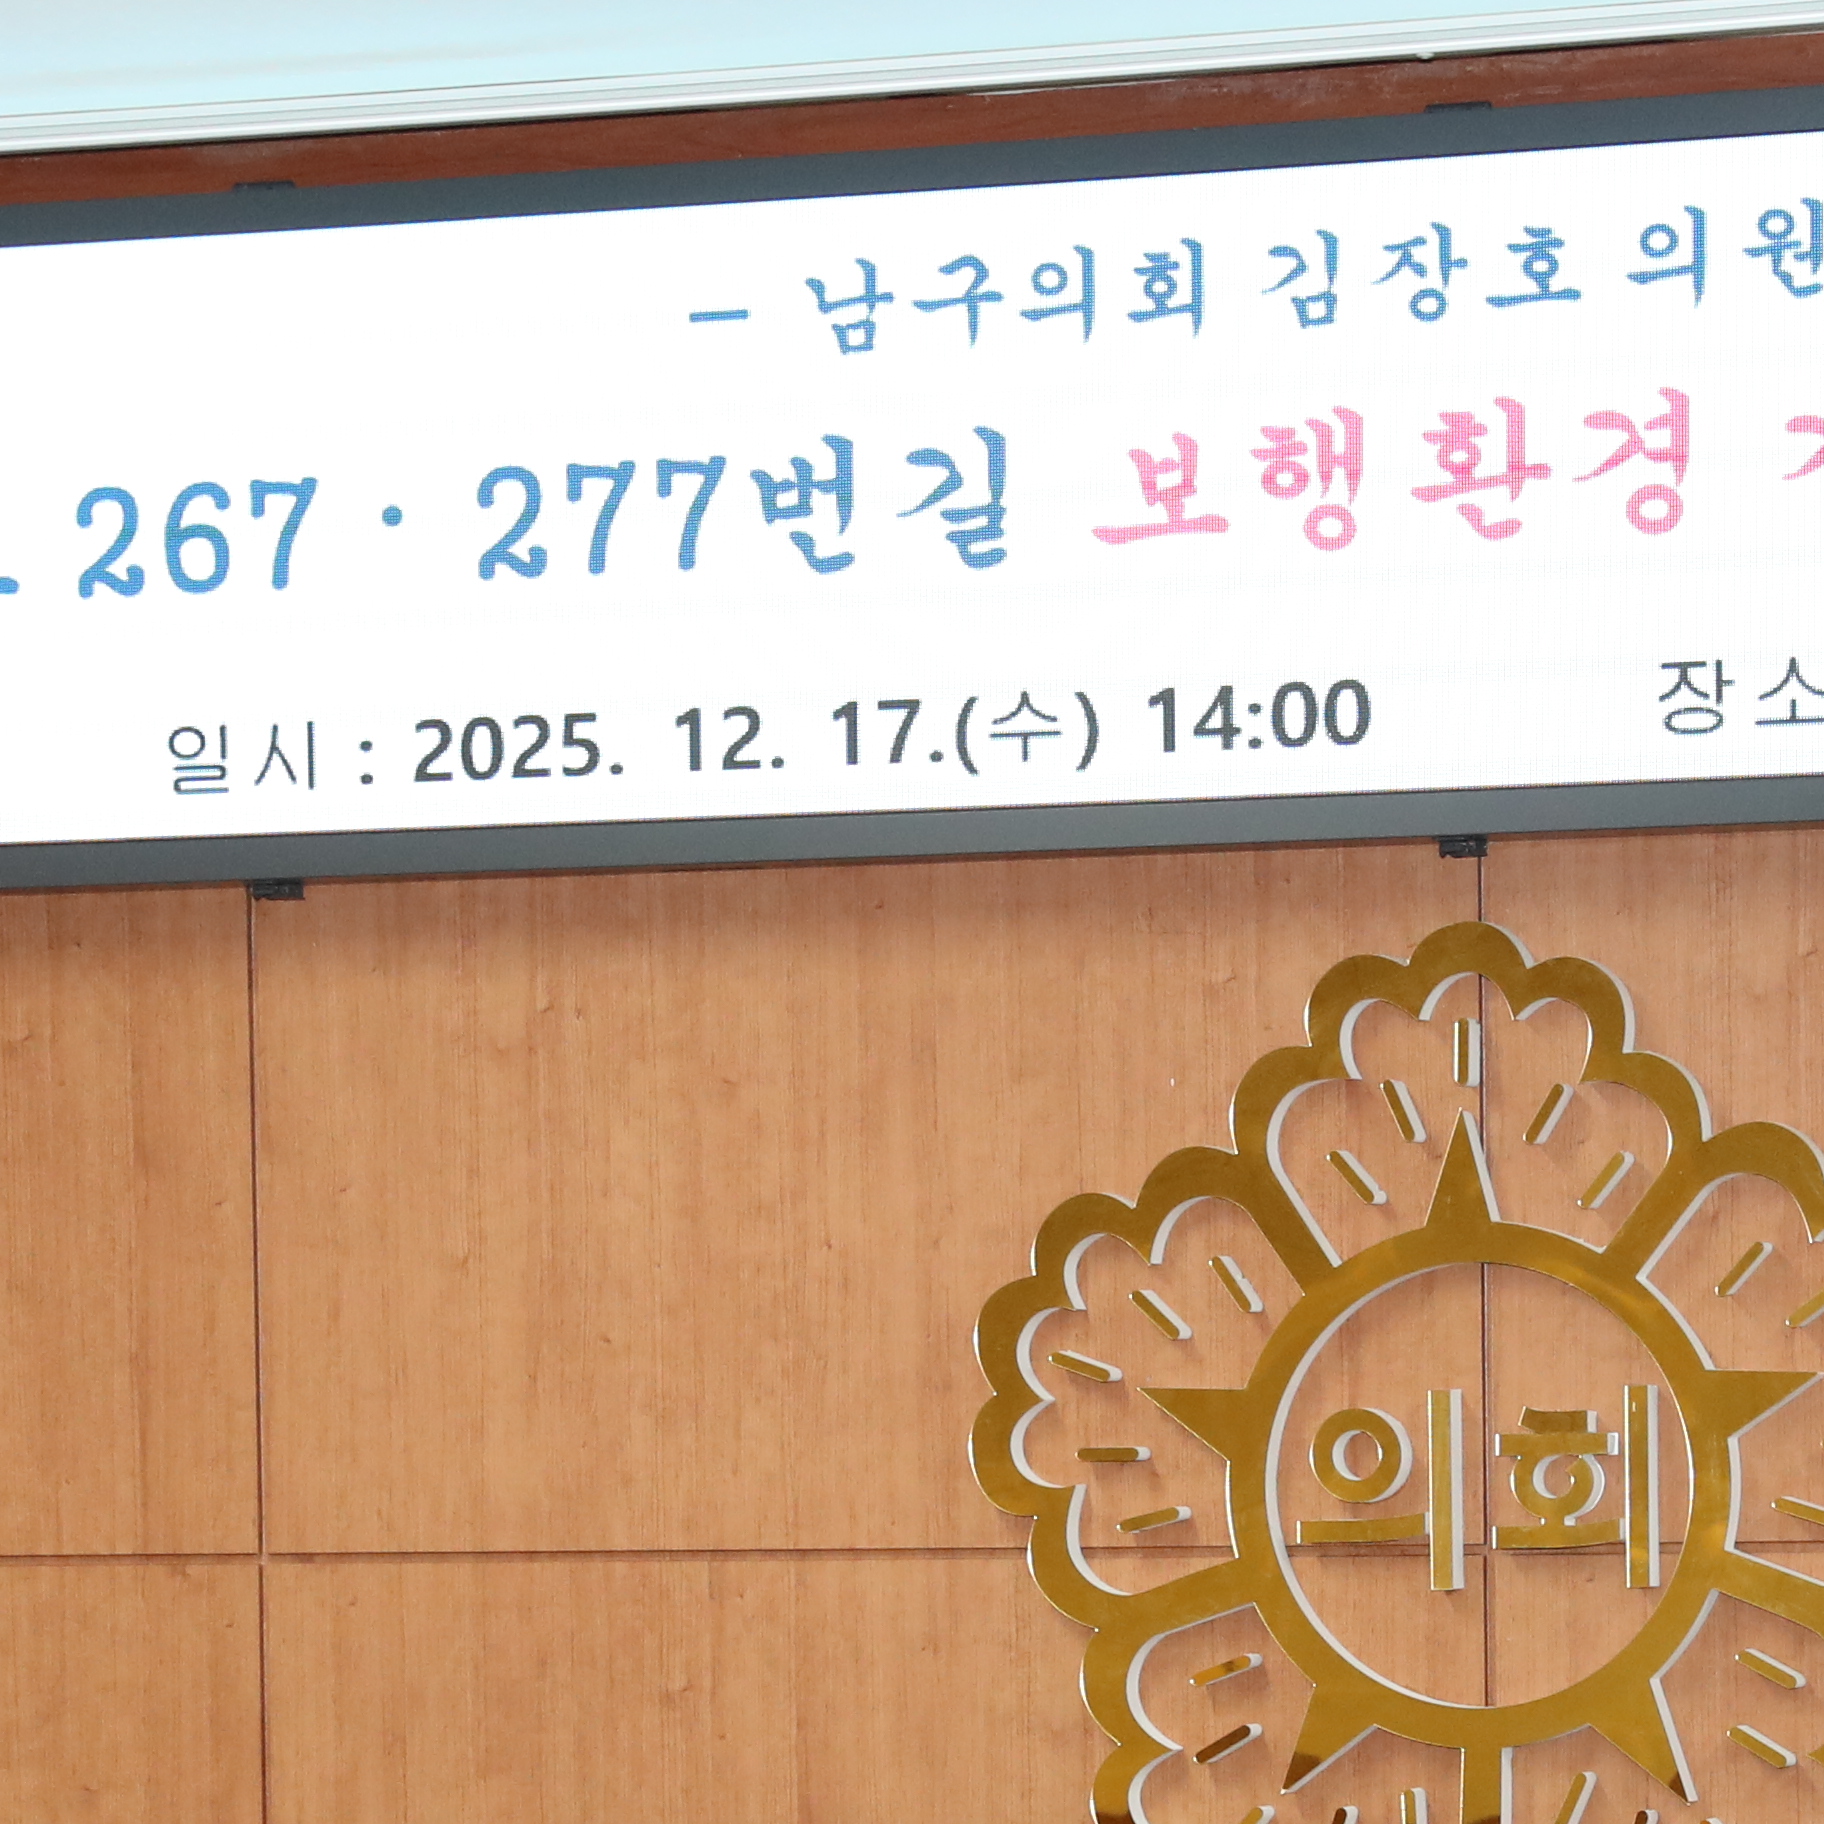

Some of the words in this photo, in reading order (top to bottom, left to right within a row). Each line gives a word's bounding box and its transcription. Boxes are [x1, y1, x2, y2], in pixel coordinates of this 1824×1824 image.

[806, 238, 1204, 354] 남구의회
[1264, 222, 1581, 328] 김장호
[1627, 197, 1824, 304] 의원
[1093, 388, 1689, 550] 보행환경
[413, 711, 624, 783] 2025.
[675, 706, 785, 771] 12.
[832, 691, 1100, 776] 17.(수)
[1148, 679, 1372, 753] 14:00
[1296, 1384, 1659, 1591] 의회
